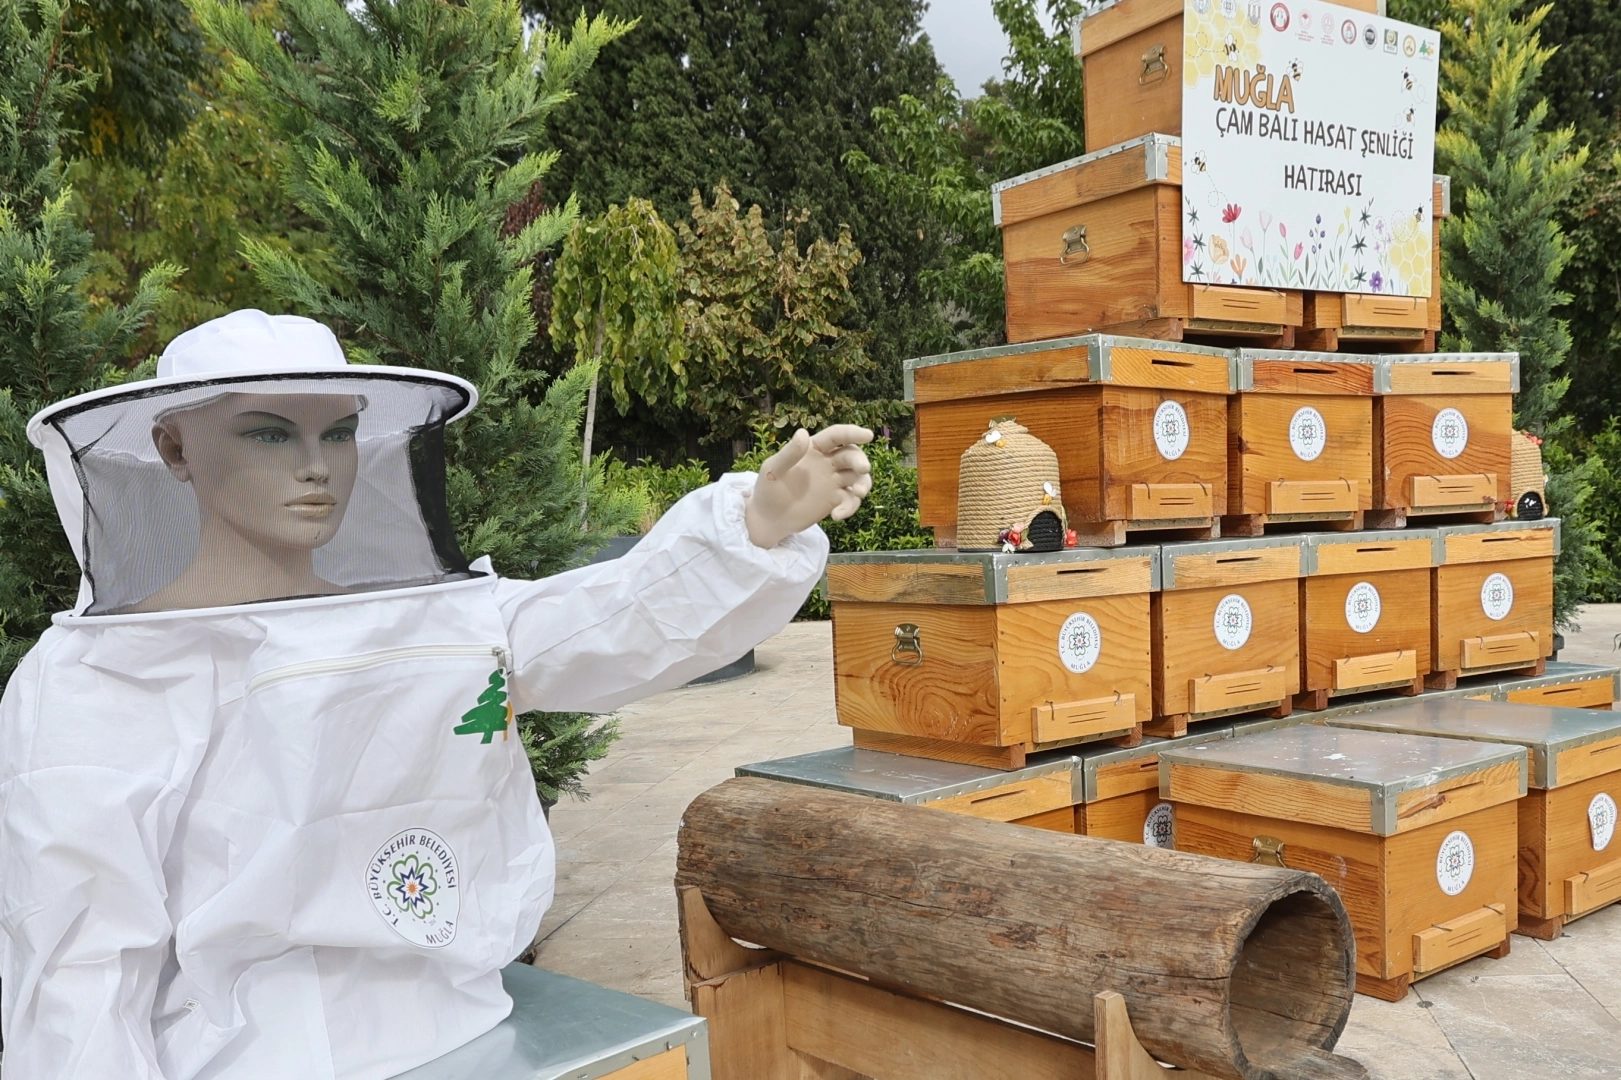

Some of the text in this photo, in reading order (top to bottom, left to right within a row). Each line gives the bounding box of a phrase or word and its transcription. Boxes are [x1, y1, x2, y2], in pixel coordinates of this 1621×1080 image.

[1214, 63, 1294, 114] MUĞLA
[1216, 107, 1414, 160] ÇAM BALI HASAT ŞENLİĞİ
[1284, 164, 1362, 196] HATIRASI
[368, 834, 456, 927] T.C. BÜYÜKŞEHİR BELEDİYESİ
[425, 920, 454, 944] MUĞLA
